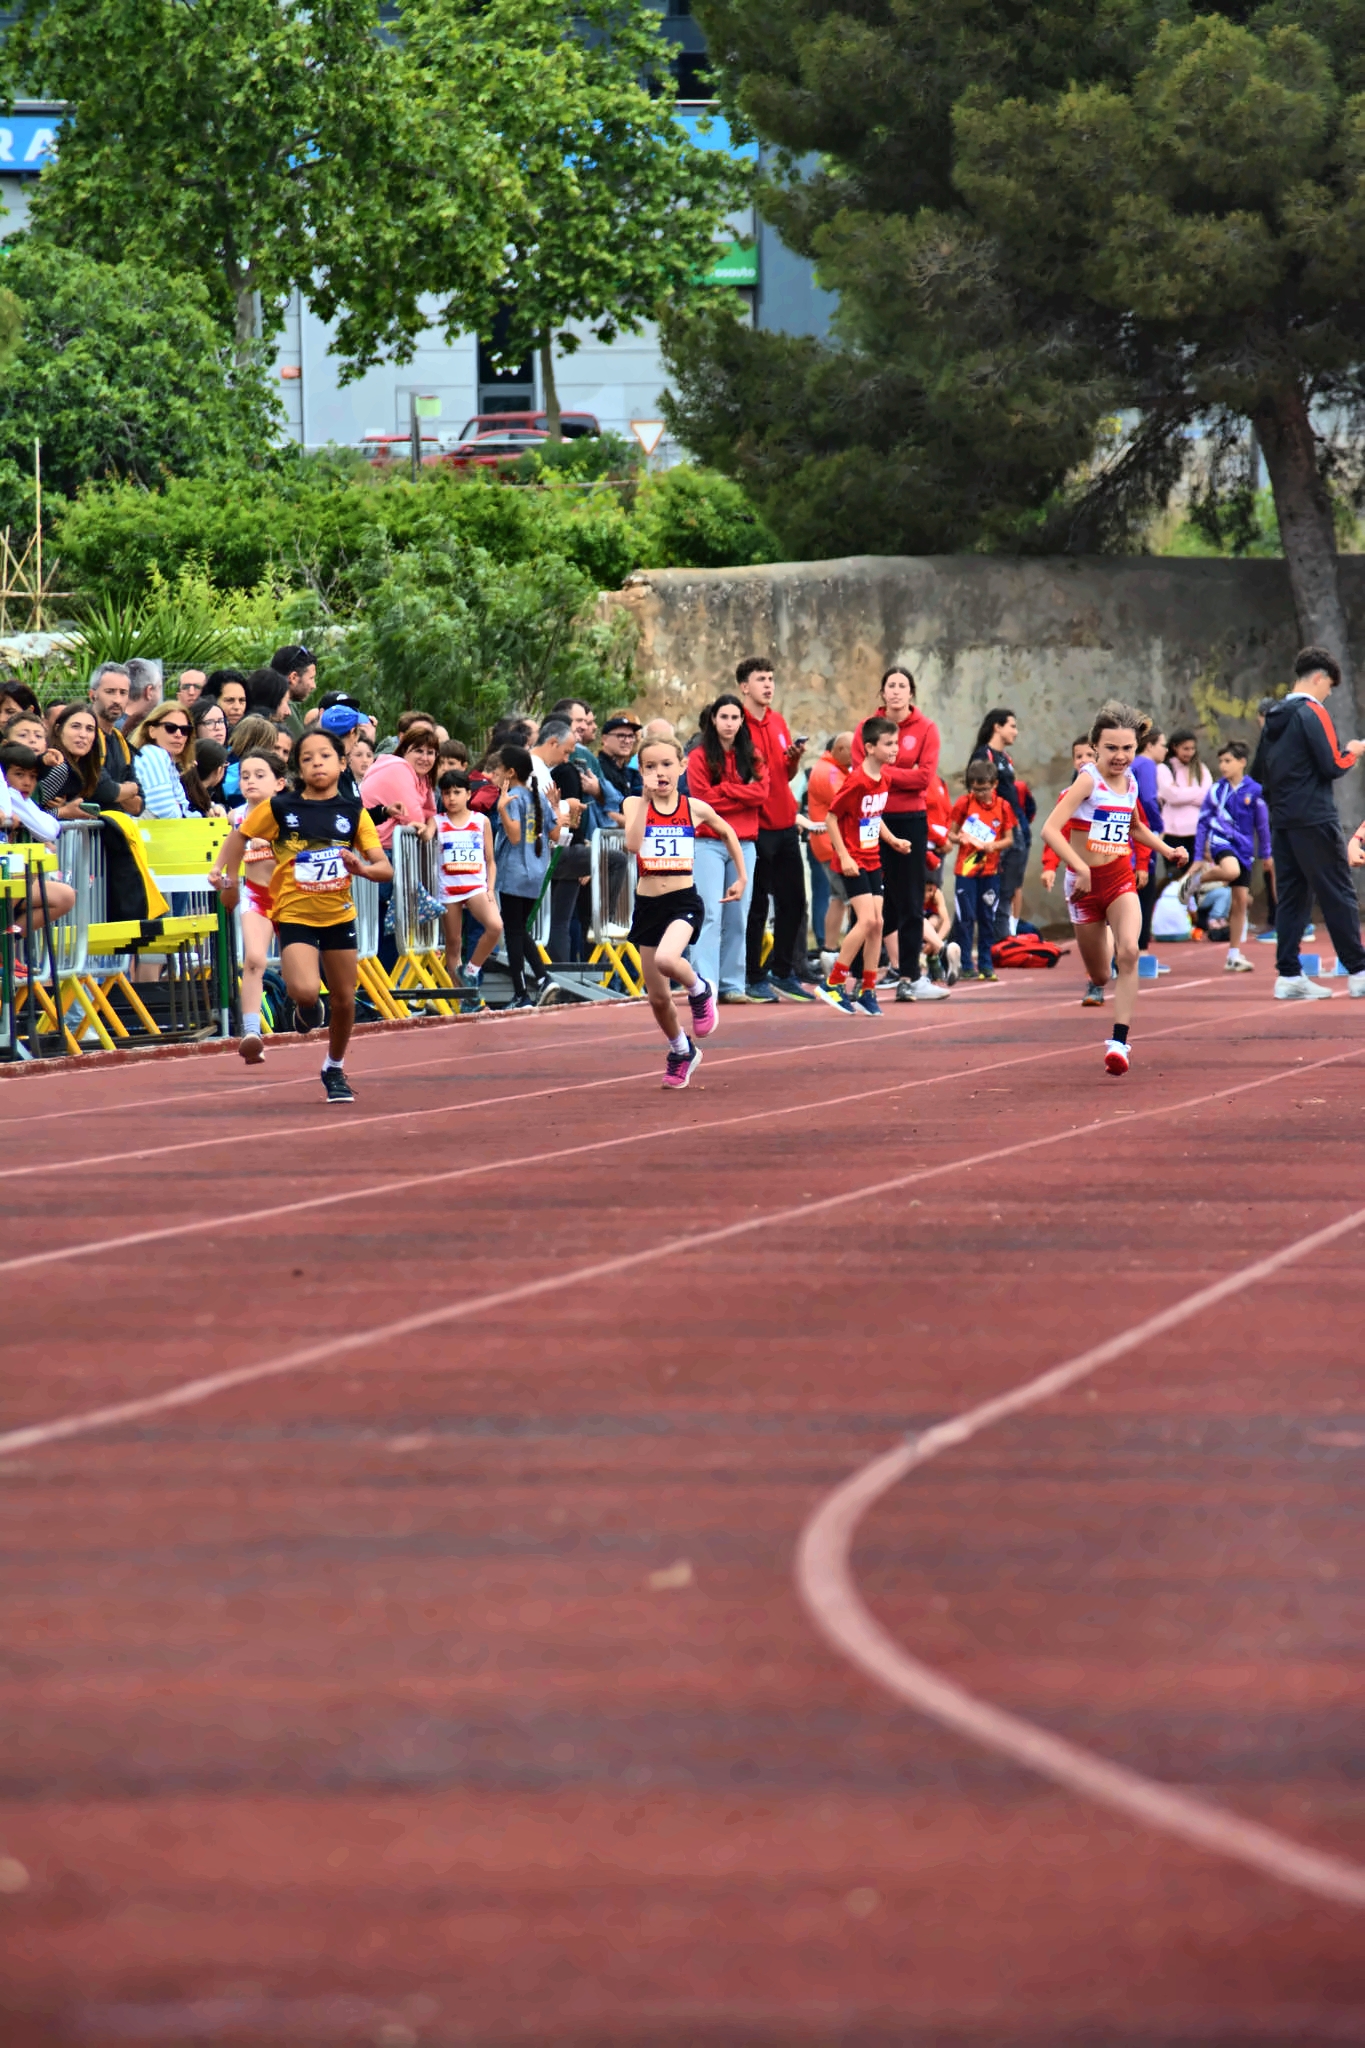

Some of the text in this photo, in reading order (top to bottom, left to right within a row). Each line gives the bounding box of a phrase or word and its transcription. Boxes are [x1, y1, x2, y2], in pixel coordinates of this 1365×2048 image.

[451, 849, 476, 862] 156
[655, 838, 680, 857] 51
[313, 860, 339, 881] 74
